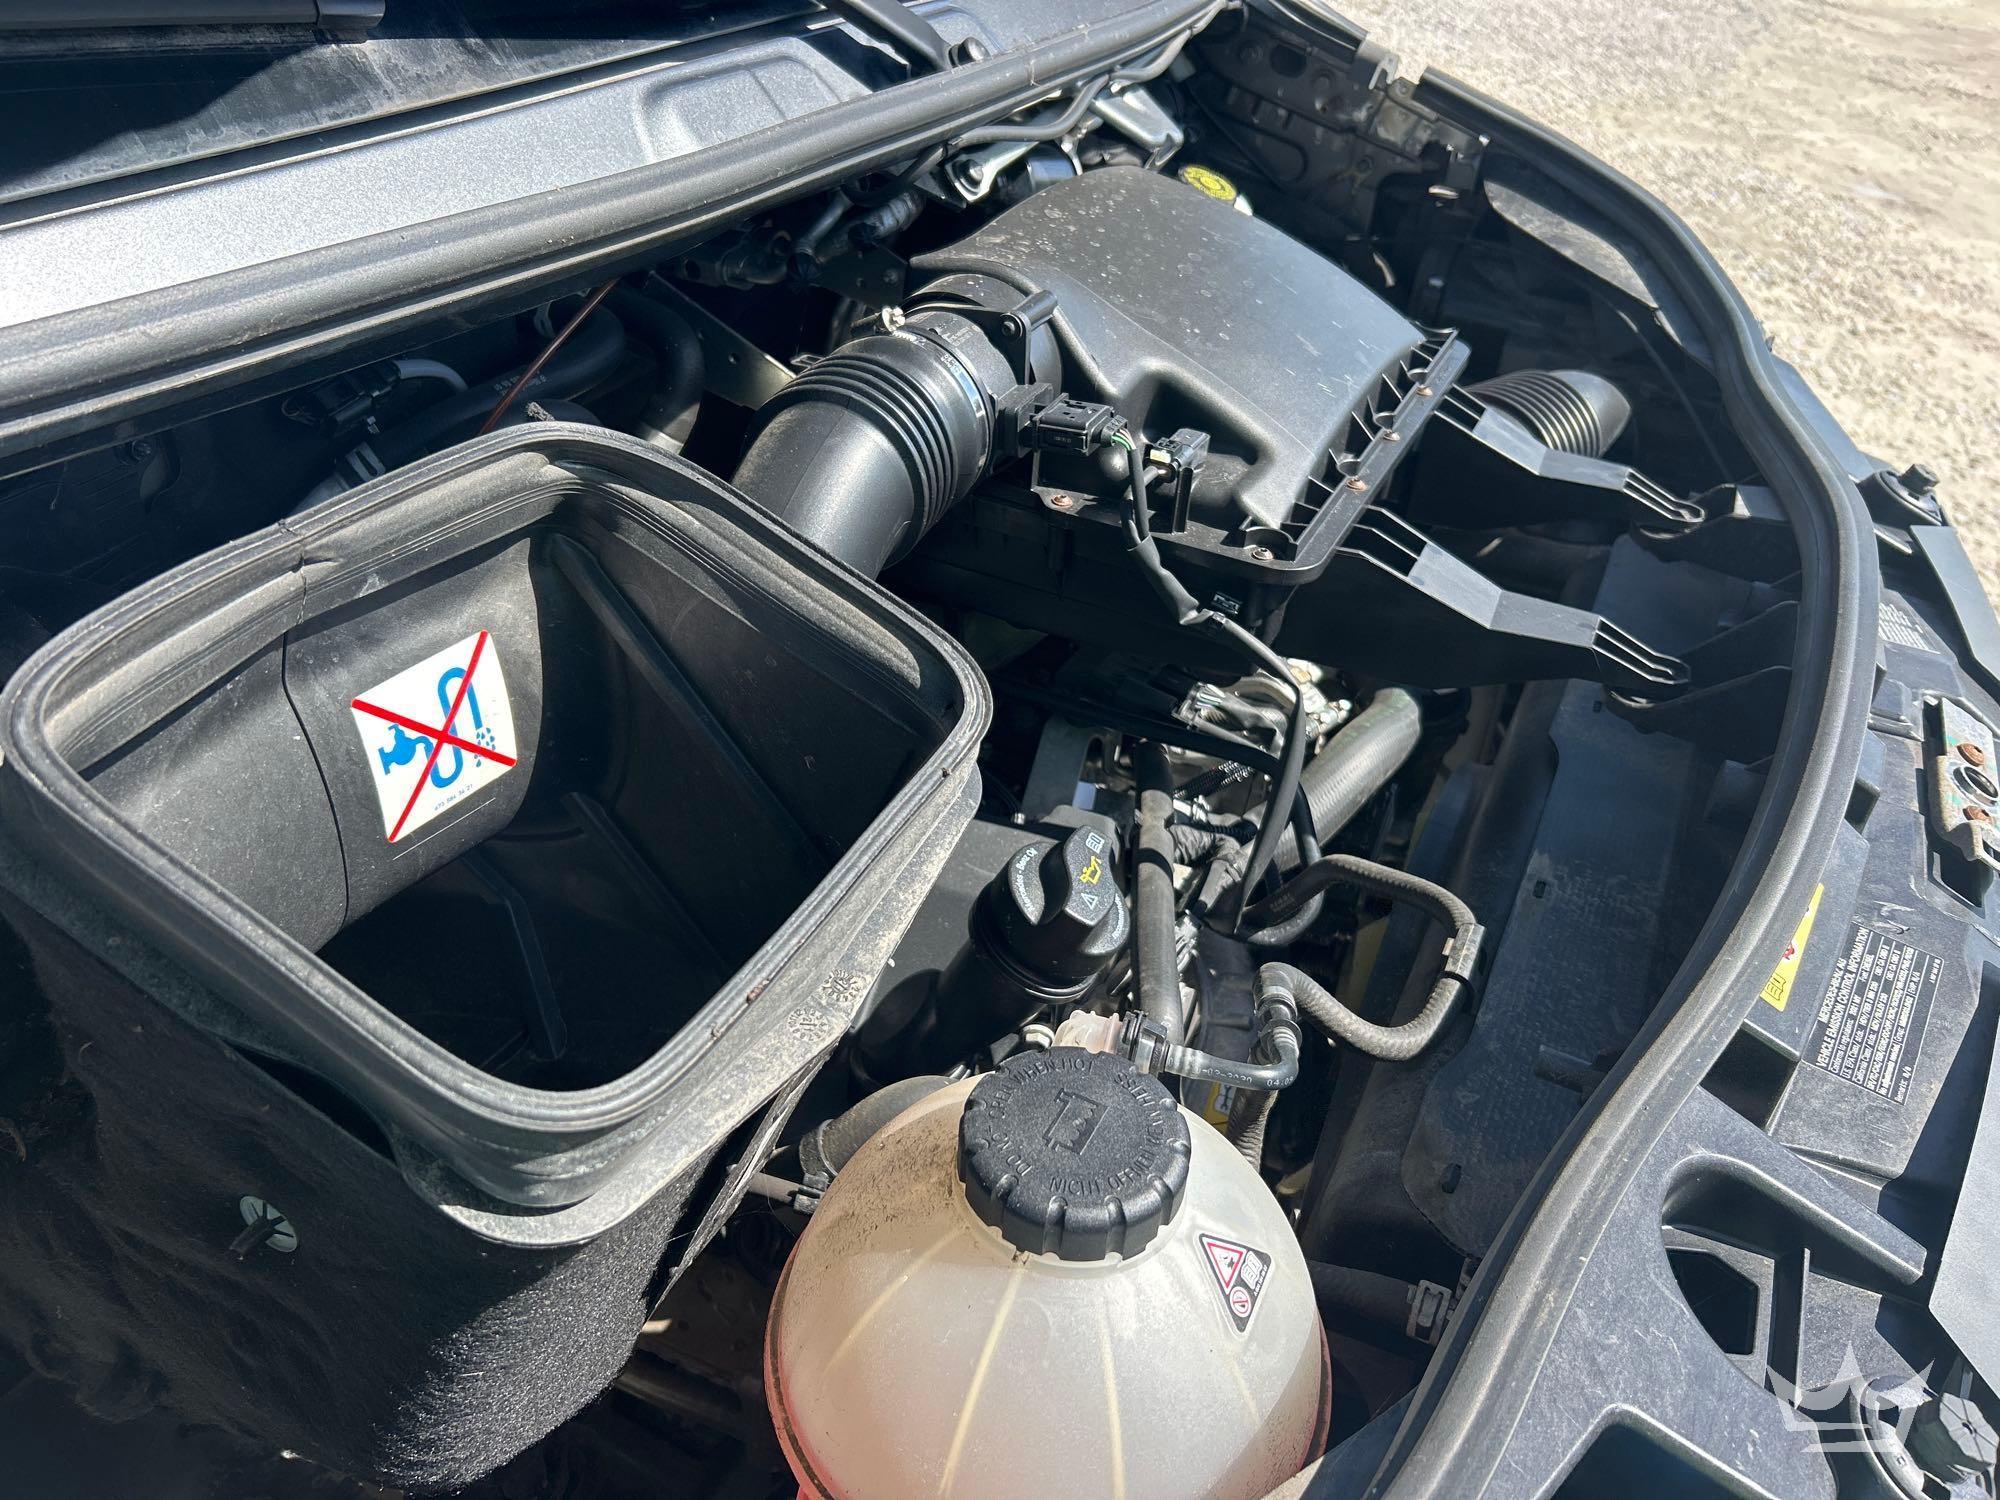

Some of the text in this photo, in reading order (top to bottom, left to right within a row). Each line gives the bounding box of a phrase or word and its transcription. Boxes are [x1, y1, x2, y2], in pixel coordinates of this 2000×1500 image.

[1026, 847, 1038, 858] Oil
[1862, 954, 1874, 971] DIESEL
[1911, 971, 1920, 982] N/A
[1816, 927, 1868, 1066] VEHICLE EMISSION CONTROL INFORMATION
[1818, 969, 1843, 1022] MERCEDES-BENZ
[1061, 1058, 1095, 1075] HOT
[1845, 1057, 1855, 1068] EPA
[1009, 1060, 1060, 1086] WHEN
[1049, 1177, 1101, 1196] NICHT
[1114, 1072, 1156, 1107] HEISS
[1006, 1154, 1032, 1177] DO
